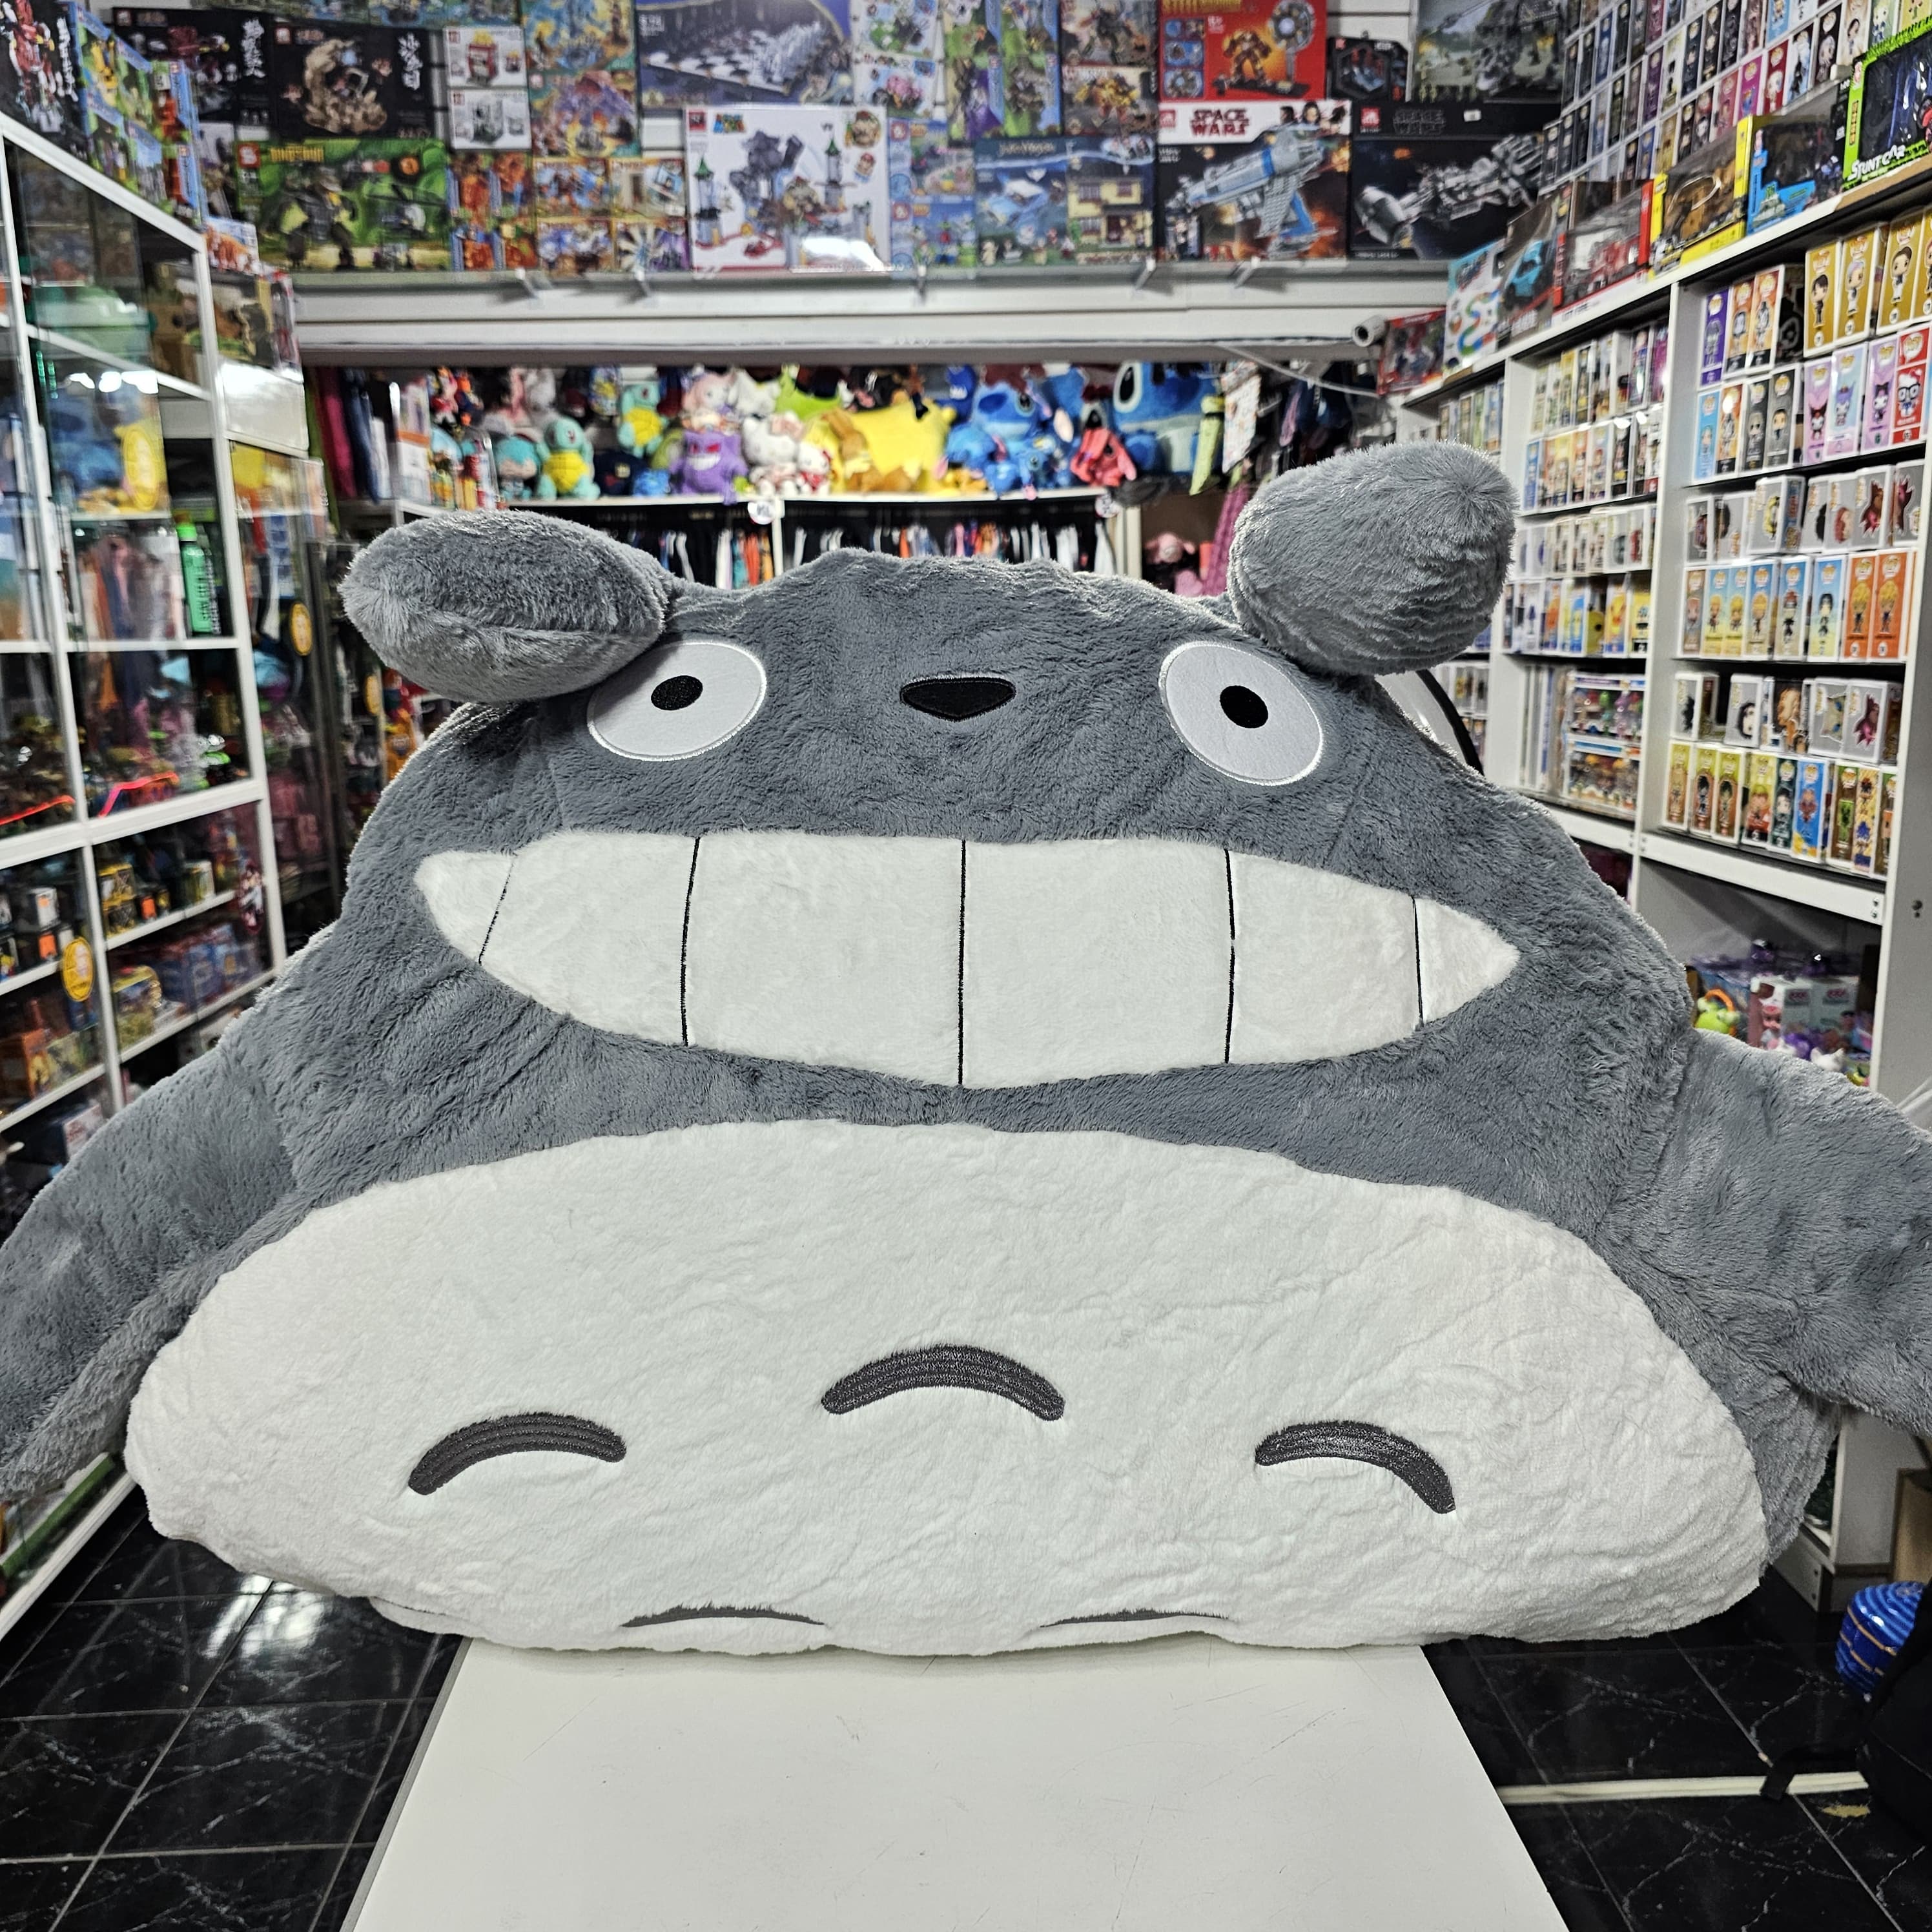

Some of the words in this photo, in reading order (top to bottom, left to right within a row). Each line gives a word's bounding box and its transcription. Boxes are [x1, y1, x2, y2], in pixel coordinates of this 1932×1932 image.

[1192, 108, 1247, 121] SPACE
[1189, 119, 1249, 136] WARS
[1847, 154, 1882, 181] STUNT
